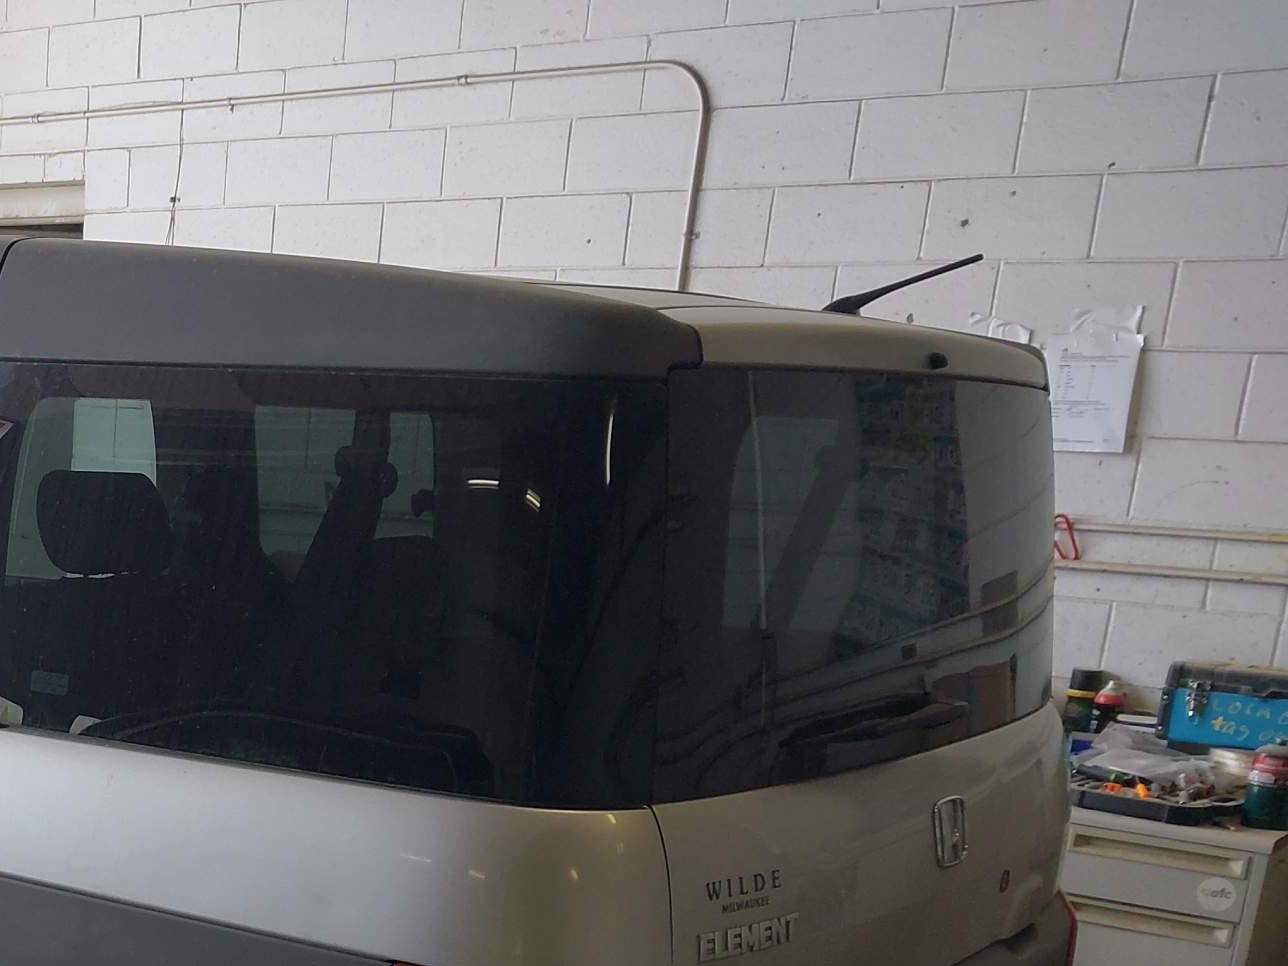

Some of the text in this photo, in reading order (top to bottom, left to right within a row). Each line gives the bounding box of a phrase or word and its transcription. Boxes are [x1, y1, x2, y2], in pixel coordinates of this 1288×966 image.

[706, 869, 782, 901] WILDE
[721, 897, 770, 913] MILWAUKEE
[697, 912, 800, 963] ELEMENT
